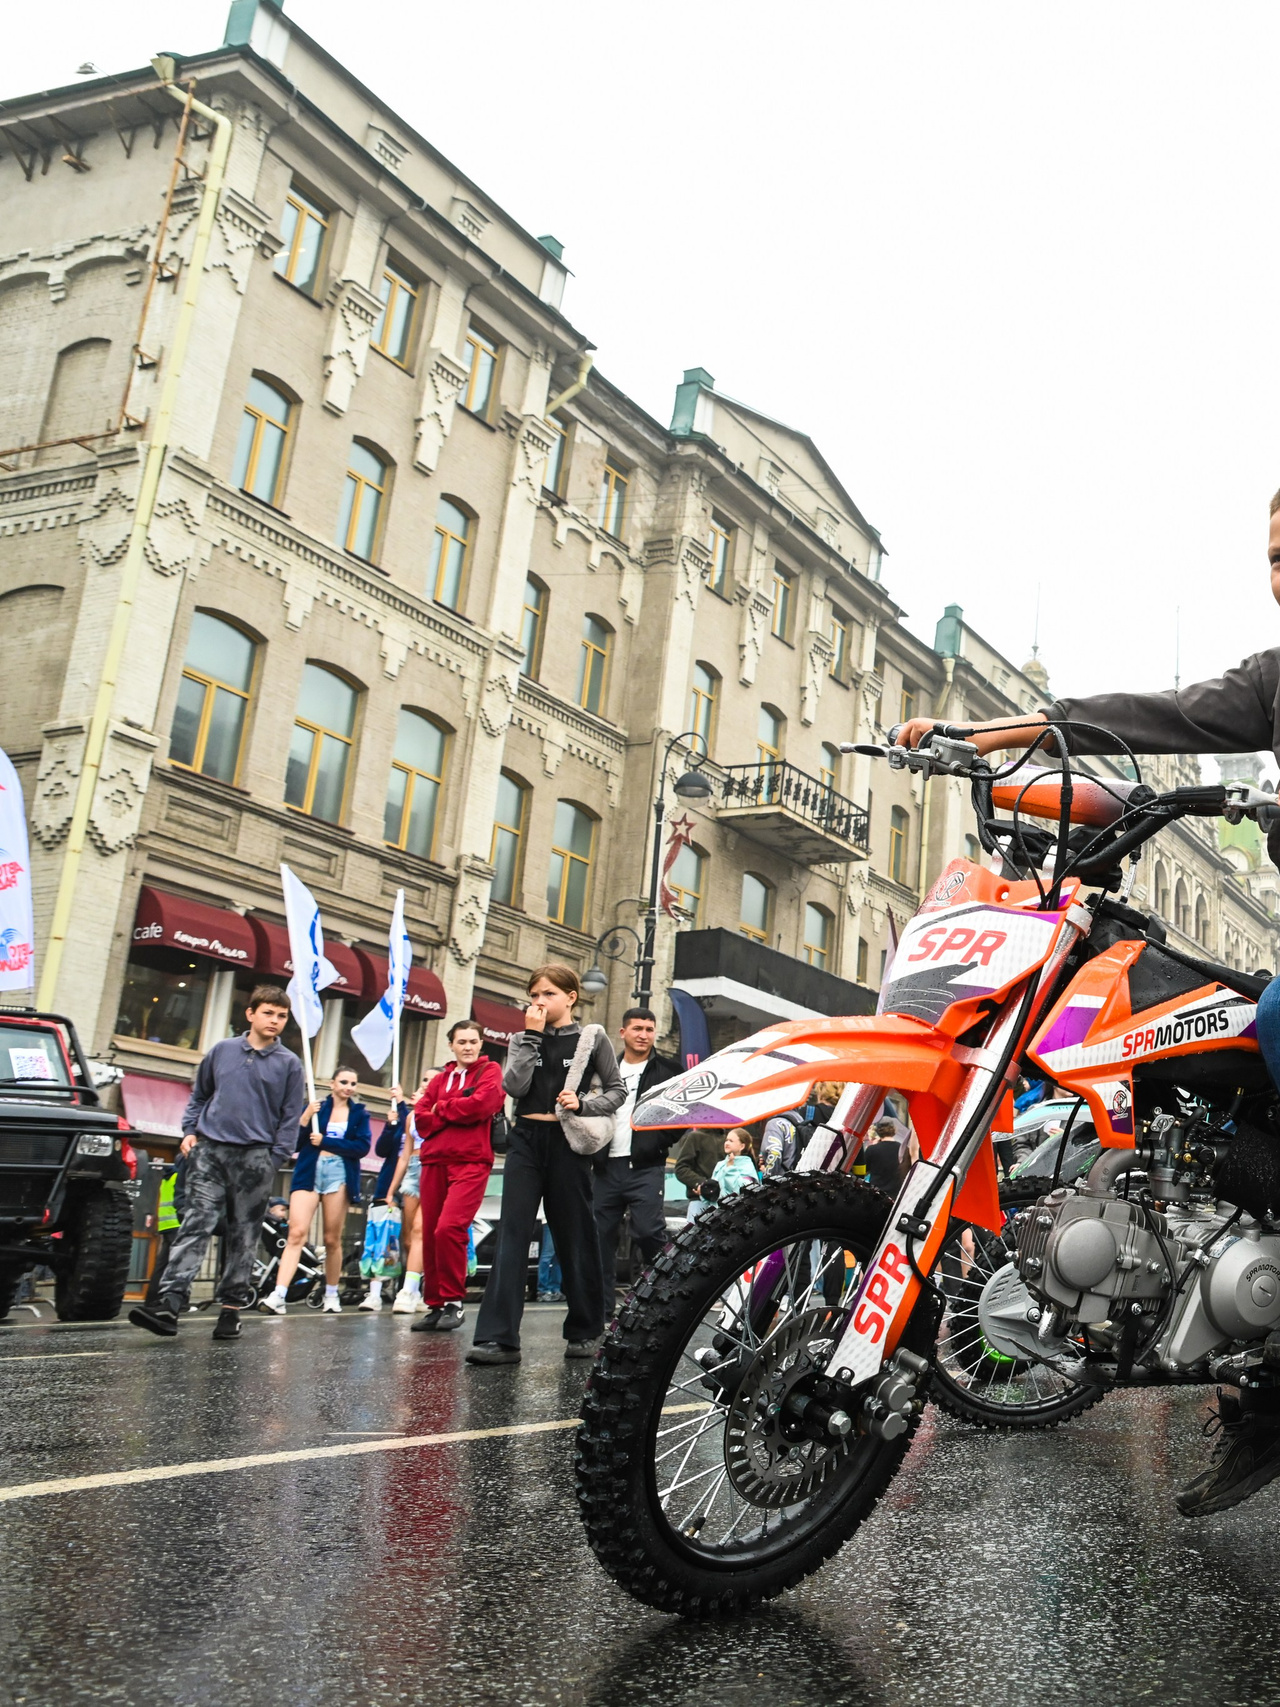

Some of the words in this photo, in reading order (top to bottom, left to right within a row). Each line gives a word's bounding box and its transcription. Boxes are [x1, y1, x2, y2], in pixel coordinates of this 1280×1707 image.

[133, 922, 163, 940] cafe
[907, 927, 1008, 966] SPR
[1122, 1009, 1229, 1058] SPRMOTORS
[853, 1243, 910, 1344] SPR
